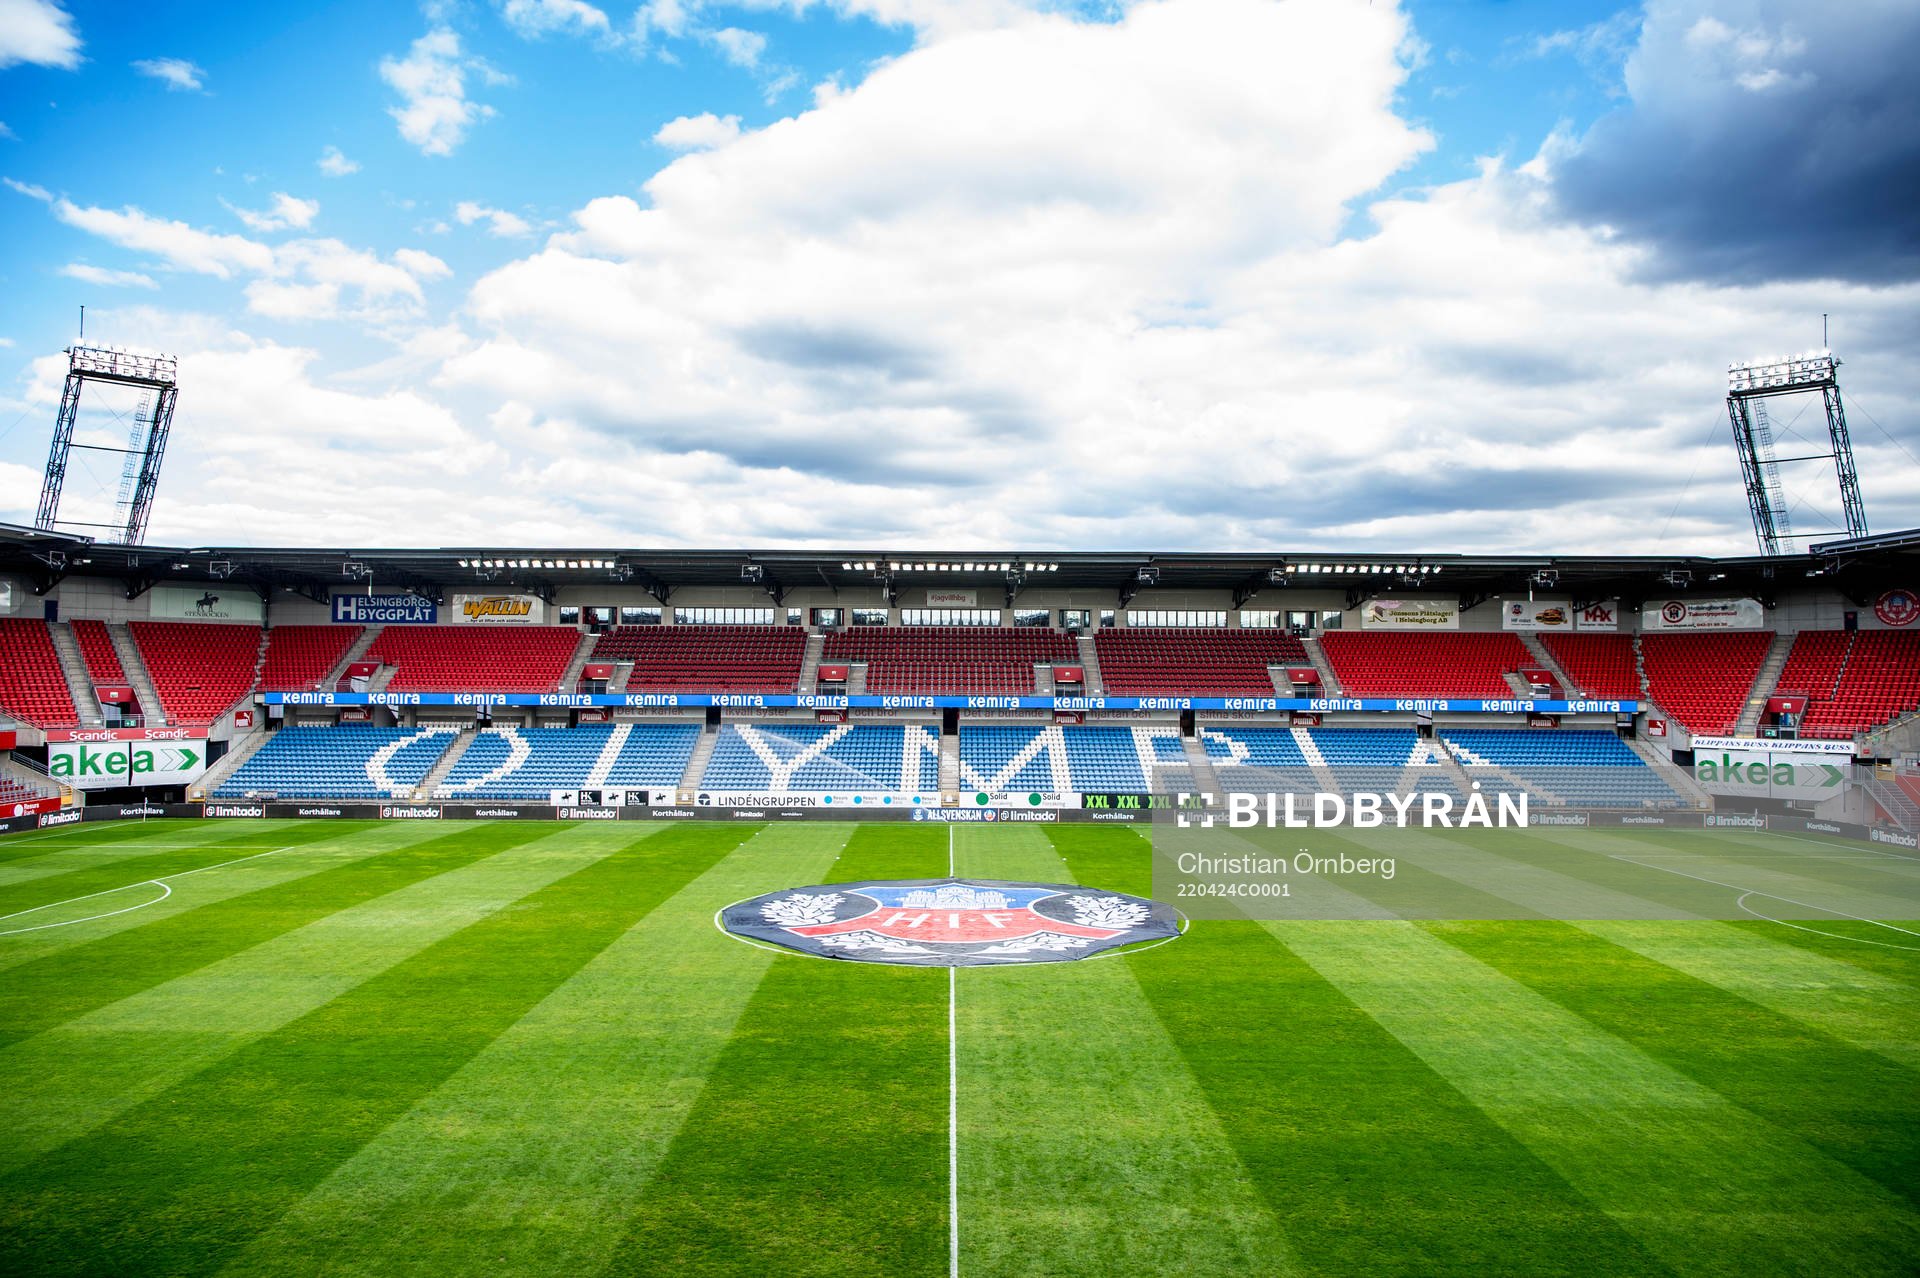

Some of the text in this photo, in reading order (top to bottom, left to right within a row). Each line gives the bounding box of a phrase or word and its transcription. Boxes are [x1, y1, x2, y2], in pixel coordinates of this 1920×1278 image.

[358, 607, 432, 620] BYGGPLÅT
[463, 597, 532, 619] WALLIN
[1584, 605, 1612, 622] MAX
[69, 730, 118, 740] Scandic
[145, 729, 190, 739] Scandic
[1694, 739, 1741, 747] KLIPPANS
[1771, 742, 1821, 750] KLIPPANS
[50, 746, 154, 776] akea
[1697, 753, 1796, 786] akea
[718, 794, 816, 806] LINDÉNGRUPPEN
[1043, 793, 1060, 801] Solid
[1086, 795, 1109, 809] XXL
[1117, 795, 1140, 809] XXL
[1148, 795, 1171, 809] XXL
[120, 808, 164, 816] Korthållare
[216, 807, 262, 817] limitado
[299, 808, 341, 816] Korthållare
[393, 807, 439, 818] limitado
[476, 809, 517, 817] Korthållare
[570, 808, 616, 819] limitado
[927, 808, 982, 821] ALLSVENSKAN
[1010, 809, 1056, 821] limitado
[1093, 812, 1135, 820] Korthållare
[48, 811, 80, 825] limitado
[1541, 814, 1588, 825] limitado
[1622, 816, 1665, 824] Korthållare
[1717, 815, 1764, 827] limitado
[1879, 829, 1918, 847] limitado
